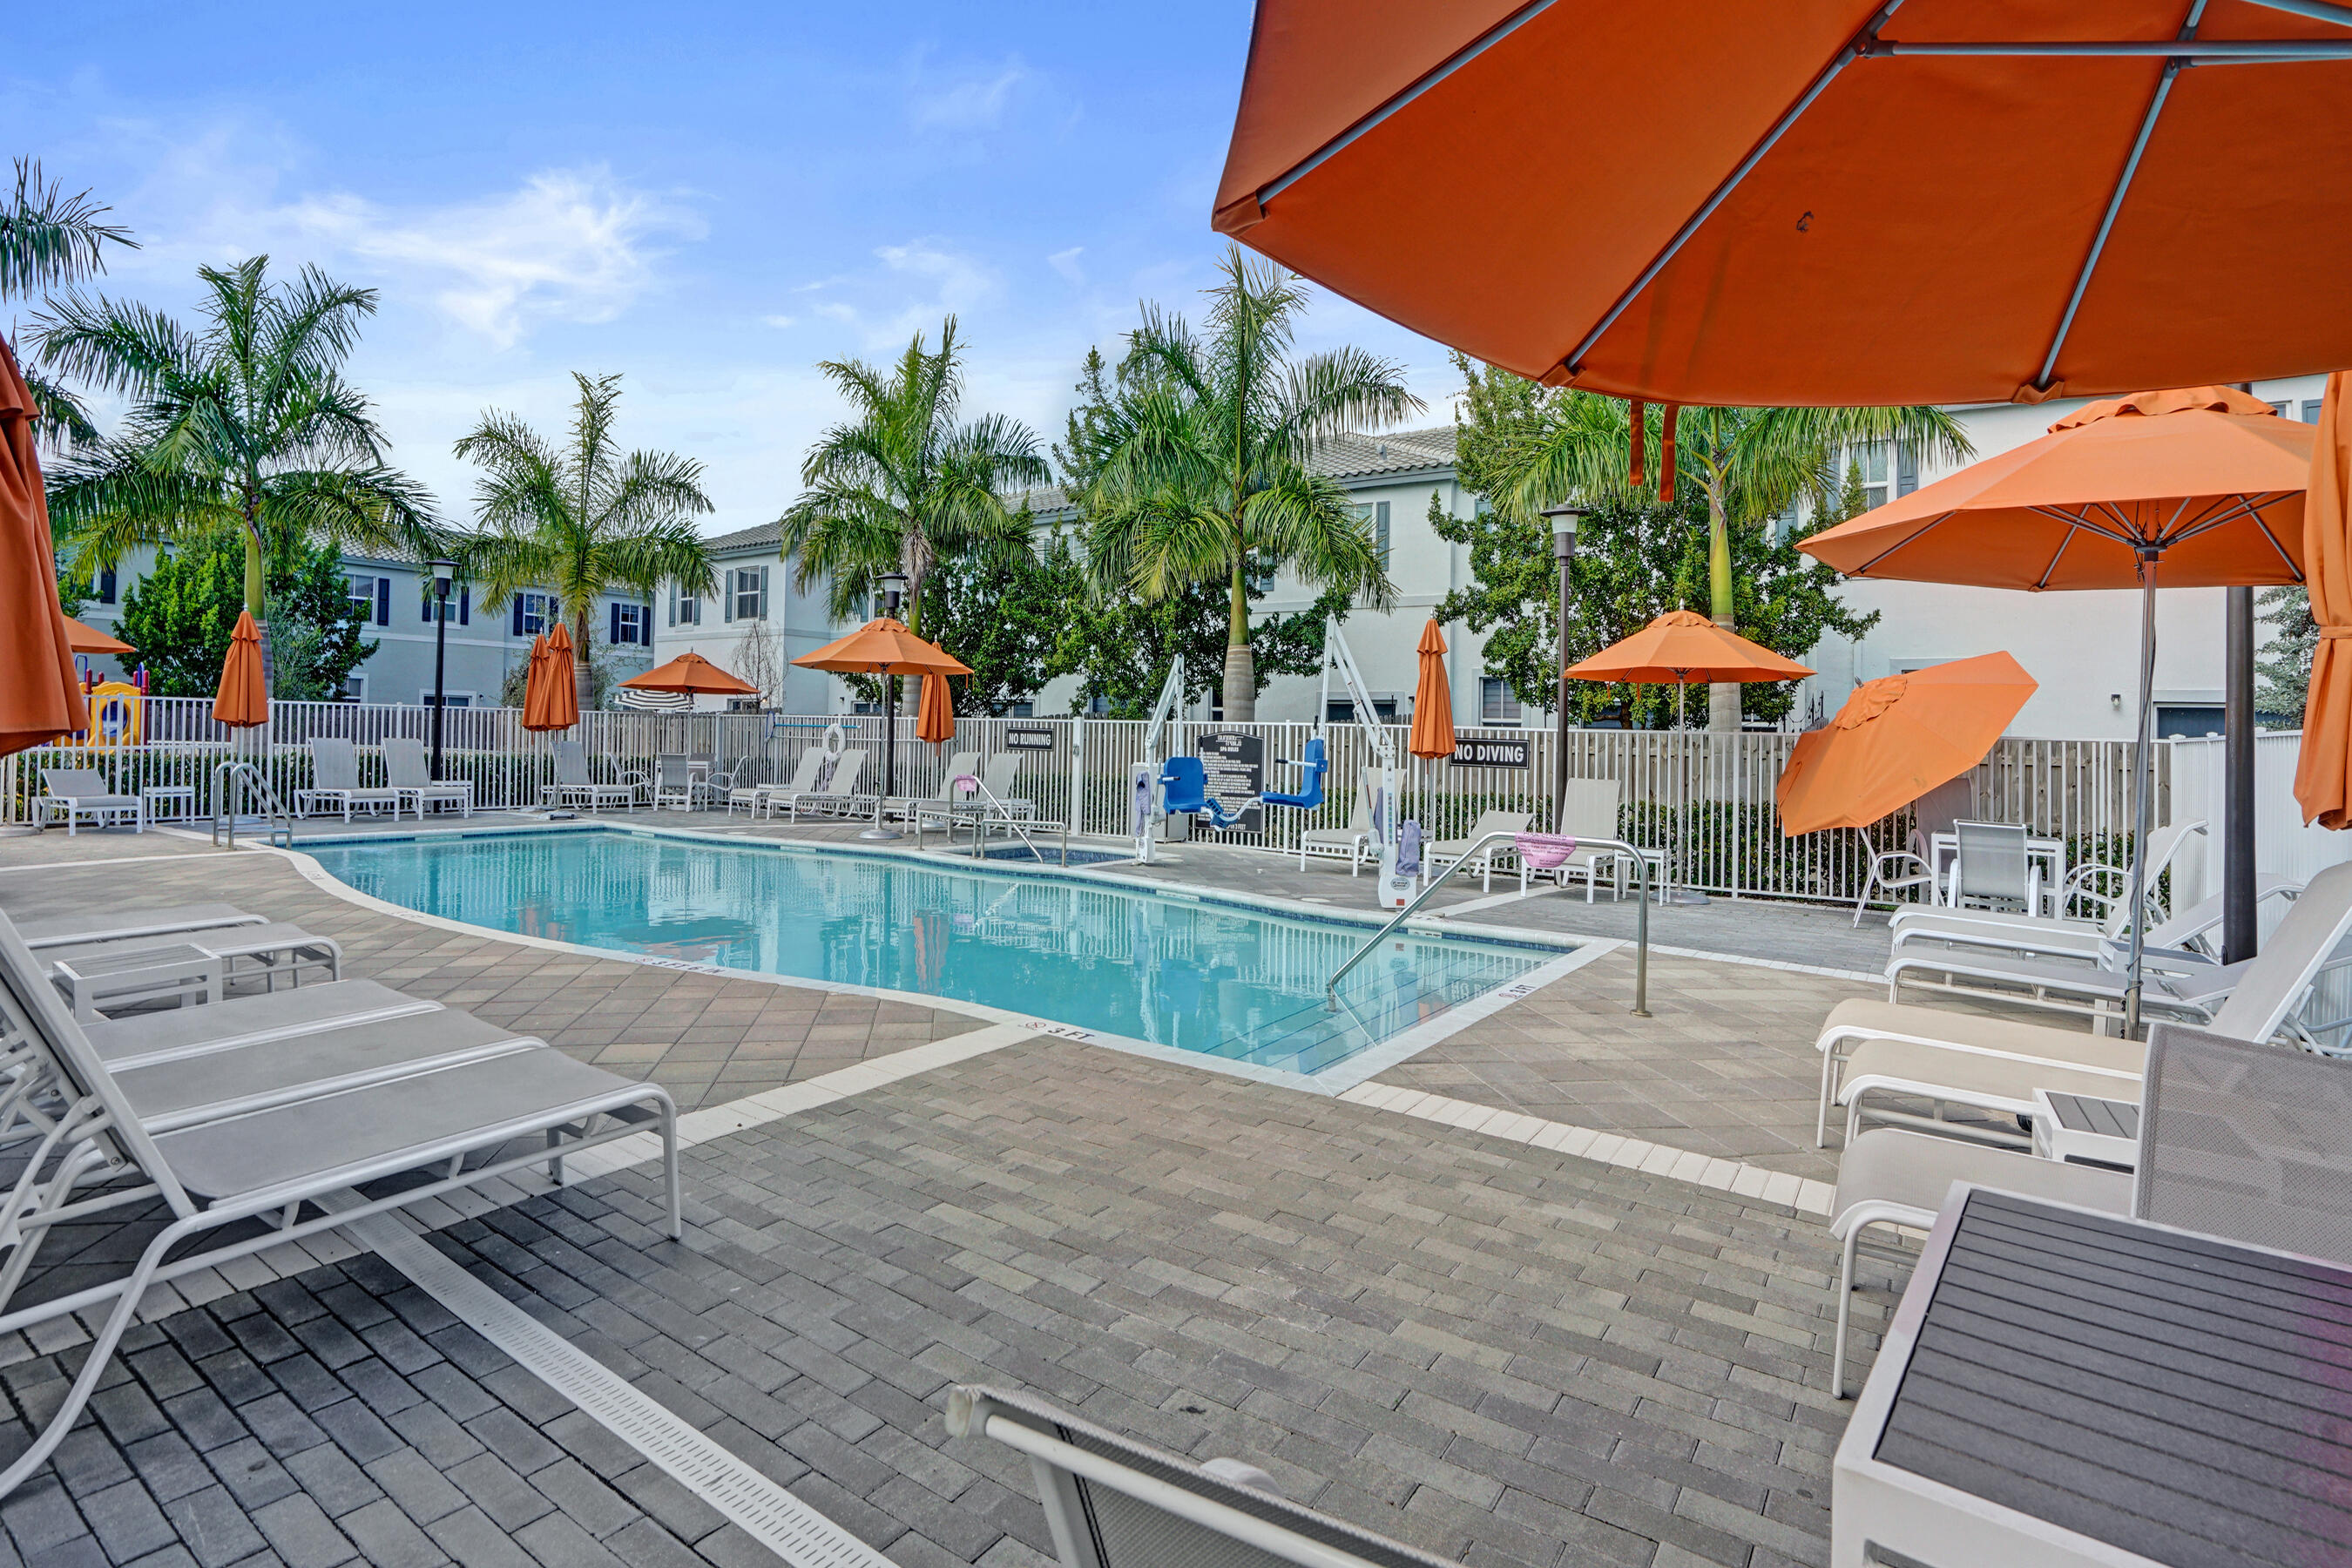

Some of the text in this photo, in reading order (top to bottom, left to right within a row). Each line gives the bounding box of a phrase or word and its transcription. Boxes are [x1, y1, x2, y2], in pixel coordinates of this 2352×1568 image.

[1008, 733, 1051, 746] NO RUNNING
[1454, 744, 1524, 763] NO DIVING
[1064, 1031, 1095, 1040] FT
